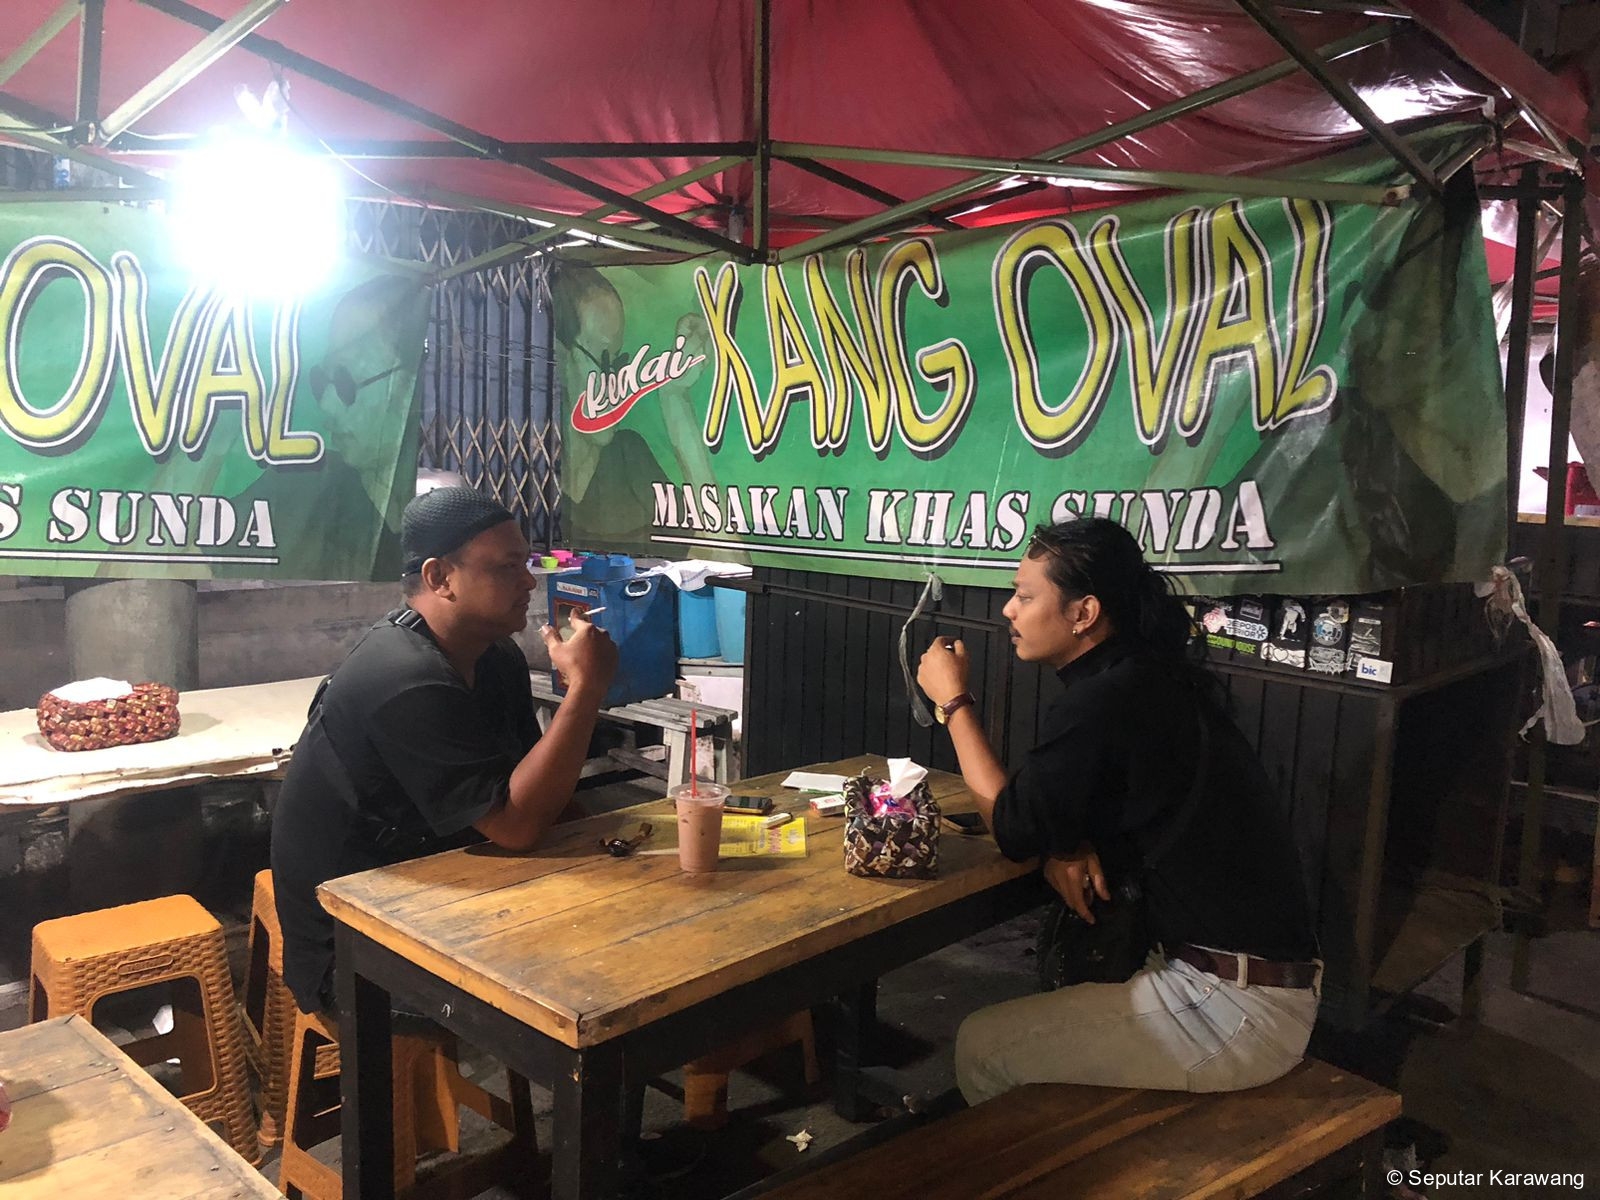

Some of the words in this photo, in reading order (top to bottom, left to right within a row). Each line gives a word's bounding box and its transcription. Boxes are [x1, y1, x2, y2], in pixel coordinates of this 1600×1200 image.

[0, 234, 325, 465] OVAL
[694, 237, 977, 455] KANG
[992, 197, 1338, 451] OVAL
[47, 486, 277, 549] SUNDA
[650, 481, 849, 541] MASAKAN
[865, 489, 1031, 552] KHAS
[1361, 663, 1377, 676] bic
